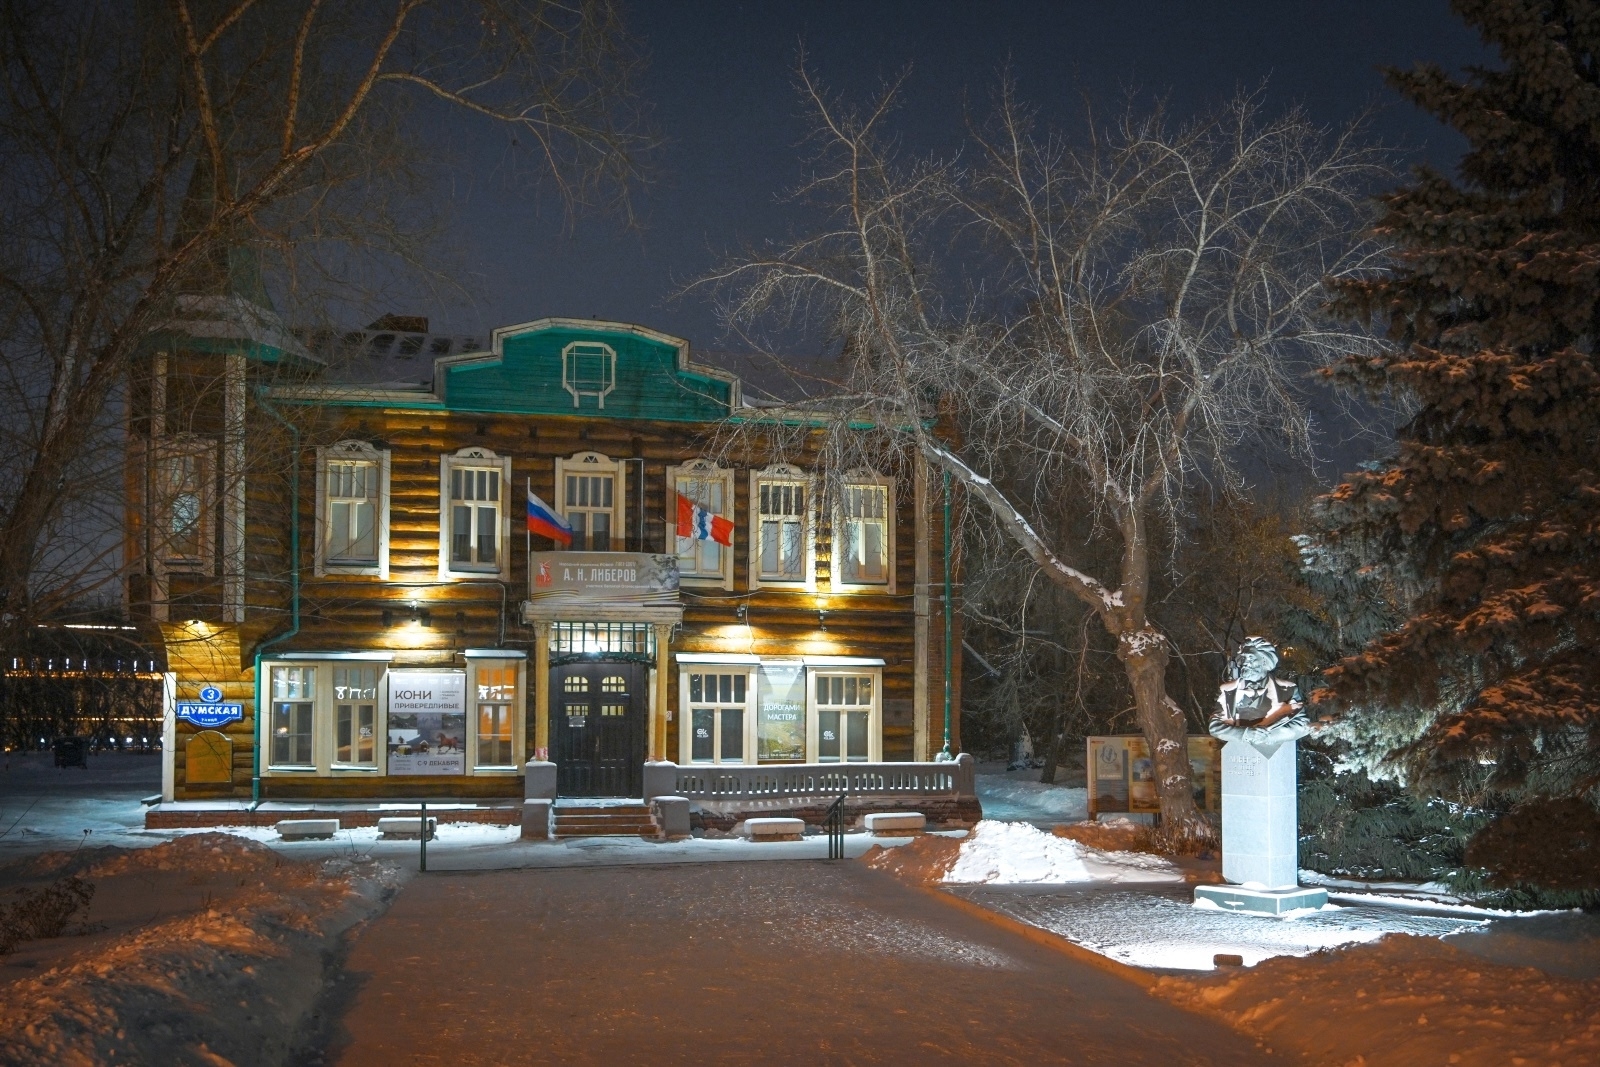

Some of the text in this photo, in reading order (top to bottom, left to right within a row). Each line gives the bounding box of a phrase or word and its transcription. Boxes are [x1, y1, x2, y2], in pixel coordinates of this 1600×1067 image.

[563, 568, 574, 581] А.
[577, 568, 587, 581] Н.
[590, 568, 636, 582] ЛИБЕРОВ
[207, 689, 215, 699] 3
[395, 690, 432, 700] КОНИ
[181, 706, 238, 716] ДУМСКАЯ
